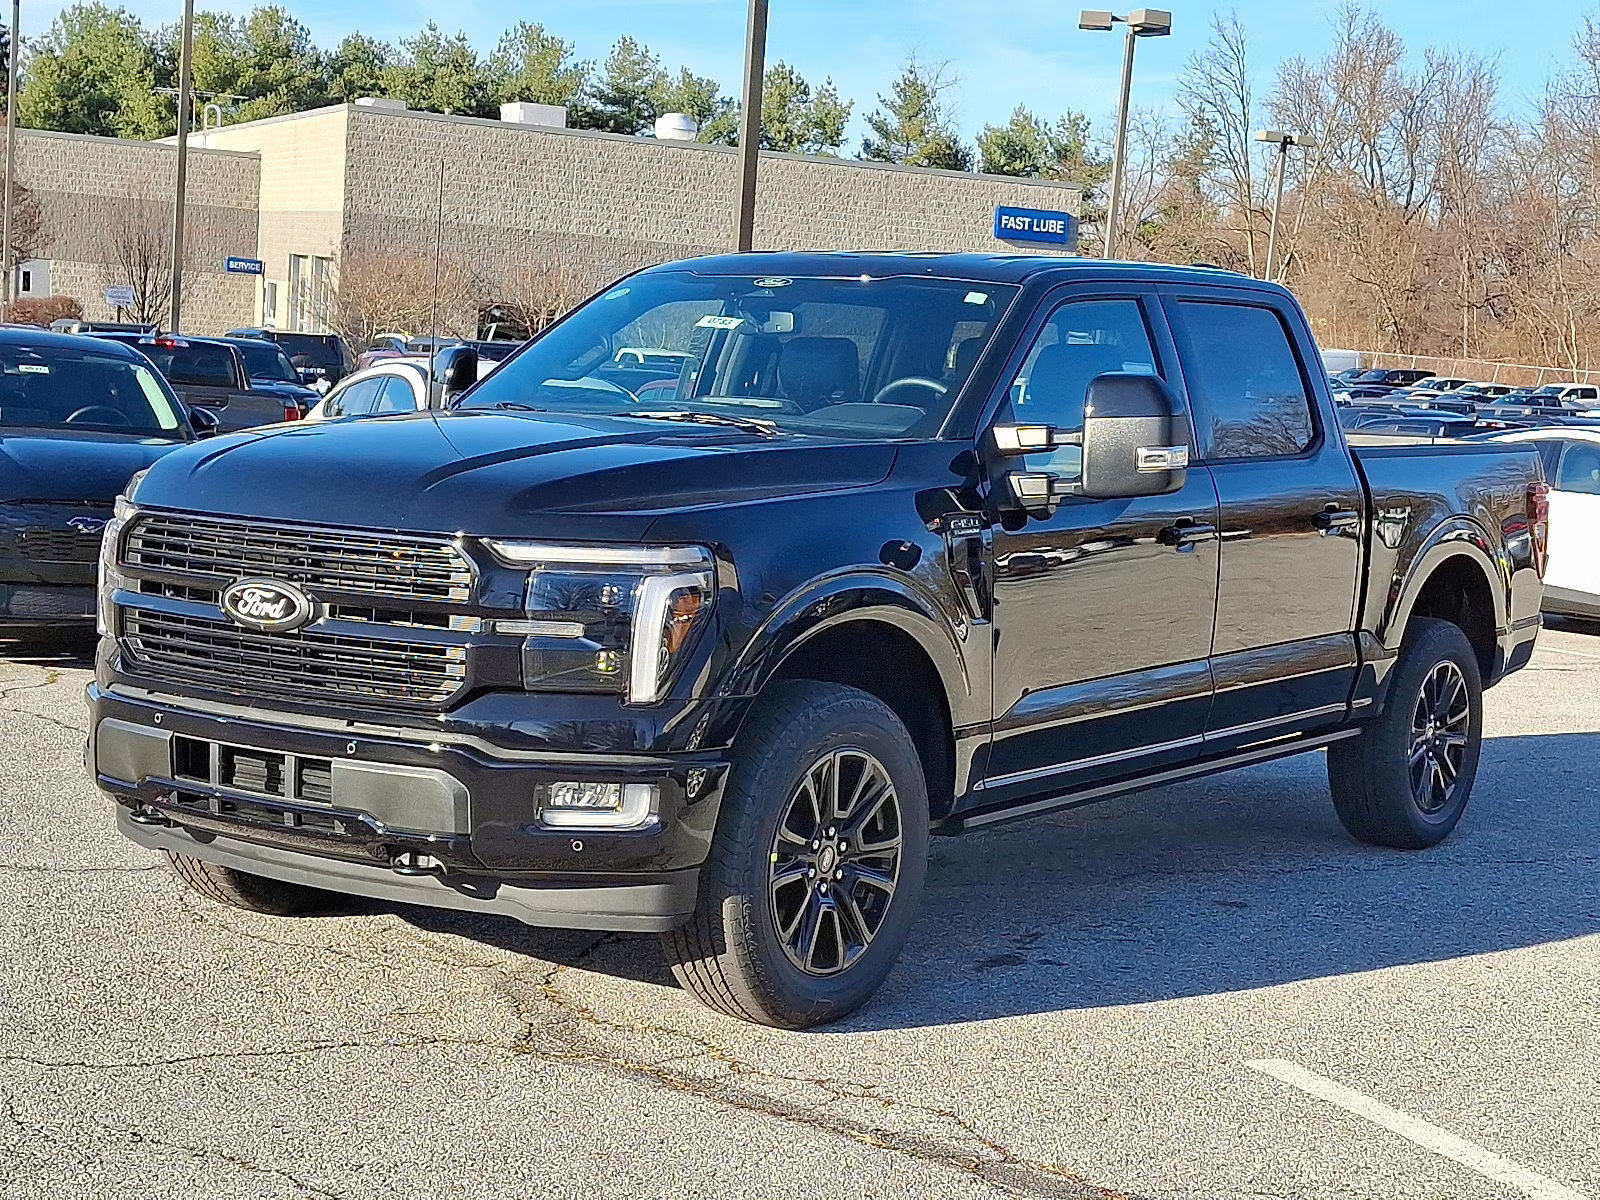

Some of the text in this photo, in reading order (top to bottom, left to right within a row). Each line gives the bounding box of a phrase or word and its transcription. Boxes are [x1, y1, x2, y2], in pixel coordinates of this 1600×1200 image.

[1001, 215, 1065, 234] FAST LUBE
[229, 260, 261, 271] SERVICE
[237, 587, 288, 619] Ford
